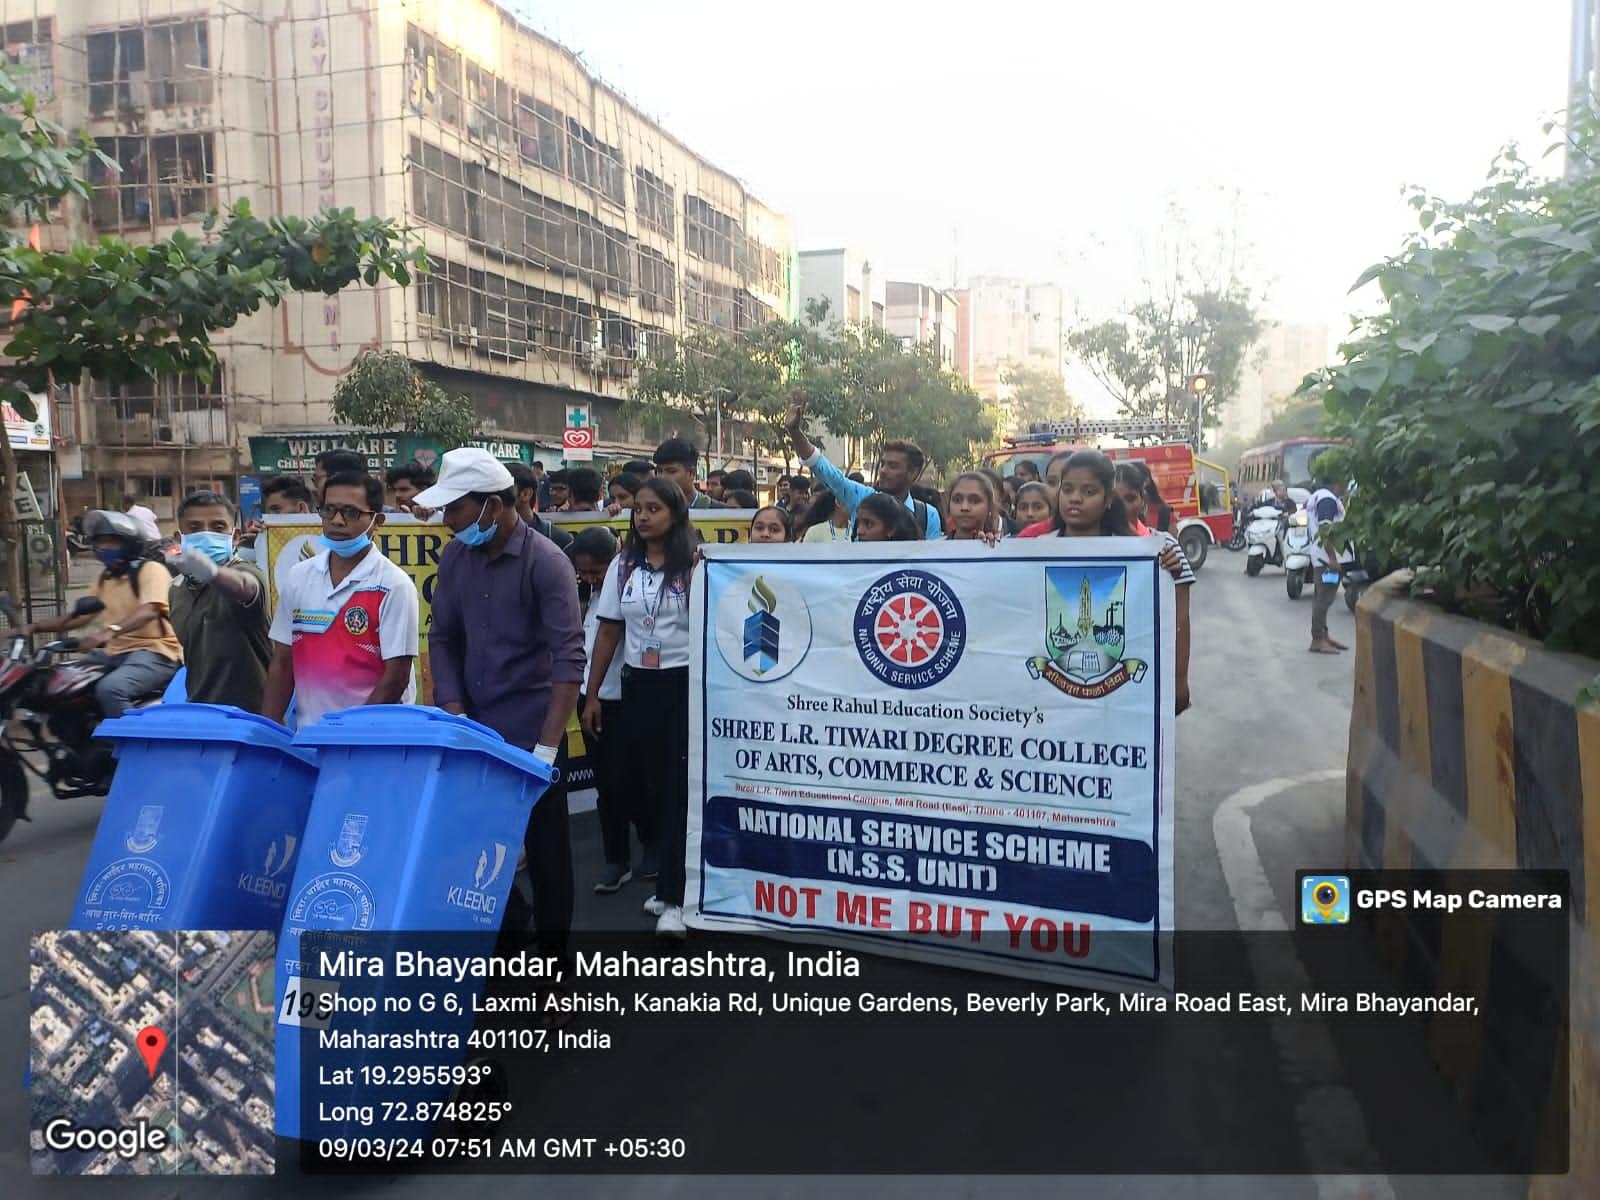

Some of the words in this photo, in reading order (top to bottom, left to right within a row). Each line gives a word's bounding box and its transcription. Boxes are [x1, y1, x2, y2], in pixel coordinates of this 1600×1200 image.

[895, 573, 924, 590] सेवा
[927, 580, 959, 620] योजना
[858, 628, 888, 678] NATIONAL
[890, 668, 936, 685] SERVICE
[934, 631, 961, 674] SCHEME
[787, 695, 829, 712] Shree
[832, 697, 878, 715] Rahul
[882, 699, 964, 720] Education
[968, 704, 1044, 728] Society's
[711, 717, 776, 742] SHREE
[781, 722, 819, 745] L.R.
[824, 725, 908, 750] TIWARI
[913, 731, 1014, 758] DEGREE
[1020, 737, 1148, 769] COLLEGE
[735, 749, 762, 769] OF
[765, 751, 823, 780] ARTS,
[828, 756, 968, 788] COMMERCE
[974, 767, 994, 789] &
[1000, 768, 1113, 800] SCIENCE
[894, 797, 914, 808] Mira
[915, 799, 940, 811] Road
[1052, 811, 1117, 828] Maharashtra
[737, 806, 856, 844] NATIONAL
[861, 819, 978, 857] SERVICE
[985, 830, 1111, 873] SCHEME
[238, 872, 287, 899] KLEENO
[827, 848, 911, 883] (N.S.S.
[917, 857, 998, 892] UNIT)
[446, 886, 497, 914] KLEENO
[755, 879, 822, 920] NOT
[836, 890, 892, 929] ME
[908, 900, 990, 944] BUT
[1003, 912, 1091, 959] YOU
